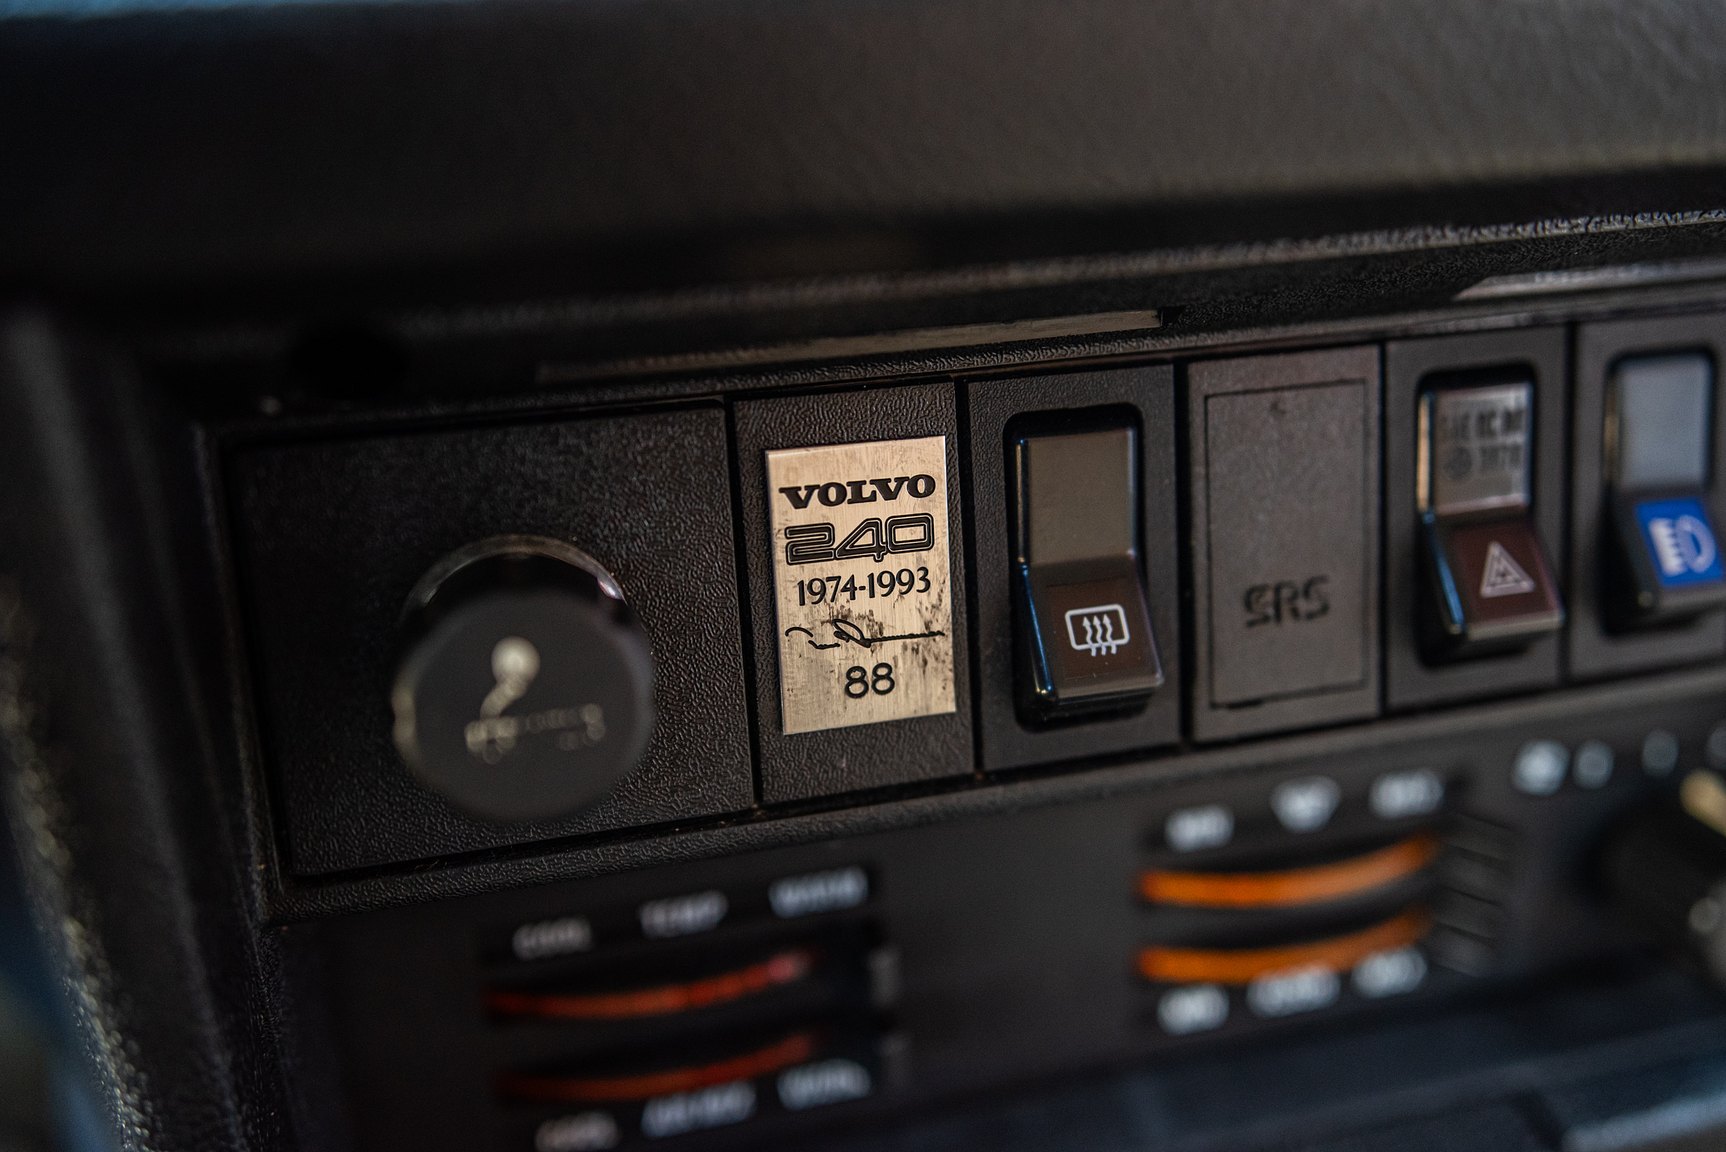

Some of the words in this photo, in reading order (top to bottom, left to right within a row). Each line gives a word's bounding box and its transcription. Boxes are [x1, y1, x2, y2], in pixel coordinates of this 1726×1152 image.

[779, 474, 936, 509] VOLVO
[784, 513, 934, 565] 240
[797, 567, 931, 606] 1974-1993
[1243, 575, 1331, 628] SRS
[846, 662, 895, 698] 88
